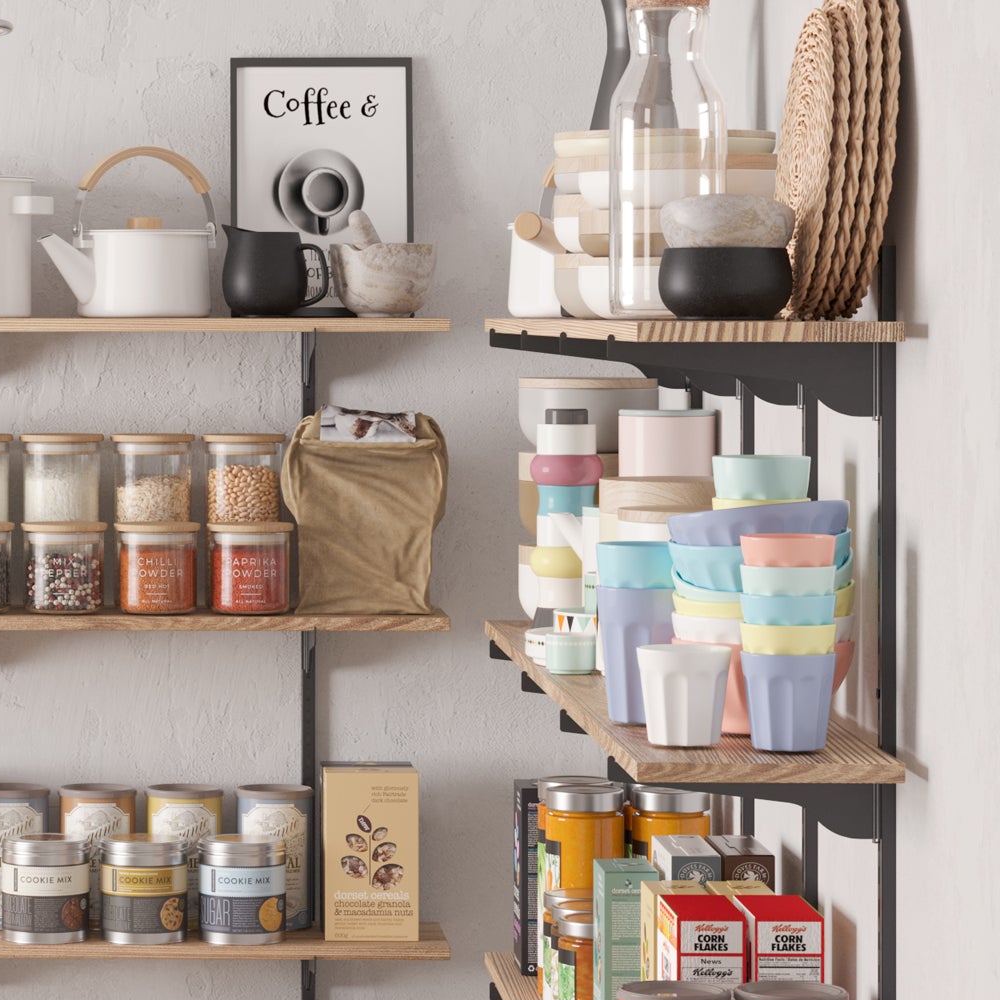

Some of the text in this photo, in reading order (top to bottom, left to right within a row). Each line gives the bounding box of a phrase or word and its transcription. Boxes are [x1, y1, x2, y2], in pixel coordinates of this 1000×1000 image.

[263, 87, 379, 126] Coffee &
[53, 557, 75, 565] MIX
[137, 557, 176, 566] CHILLI
[226, 557, 277, 566] PAPRIKA
[680, 864, 713, 879] DOVES FARM
[735, 864, 767, 879] DOVES FARM
[20, 876, 55, 884] COOKIE
[119, 876, 172, 885] COOKIE MIX
[218, 876, 271, 885] COOKIE MIX
[334, 890, 409, 900] dorset cereals
[334, 900, 411, 909] chocolate granola
[695, 924, 728, 933] Kellogg's
[771, 924, 807, 933] Kellogg's
[698, 935, 725, 943] CORN
[775, 935, 803, 943] CORN
[694, 943, 728, 951] FLAKES
[771, 943, 807, 951] FLAKES
[693, 967, 733, 977] Kellogg's
